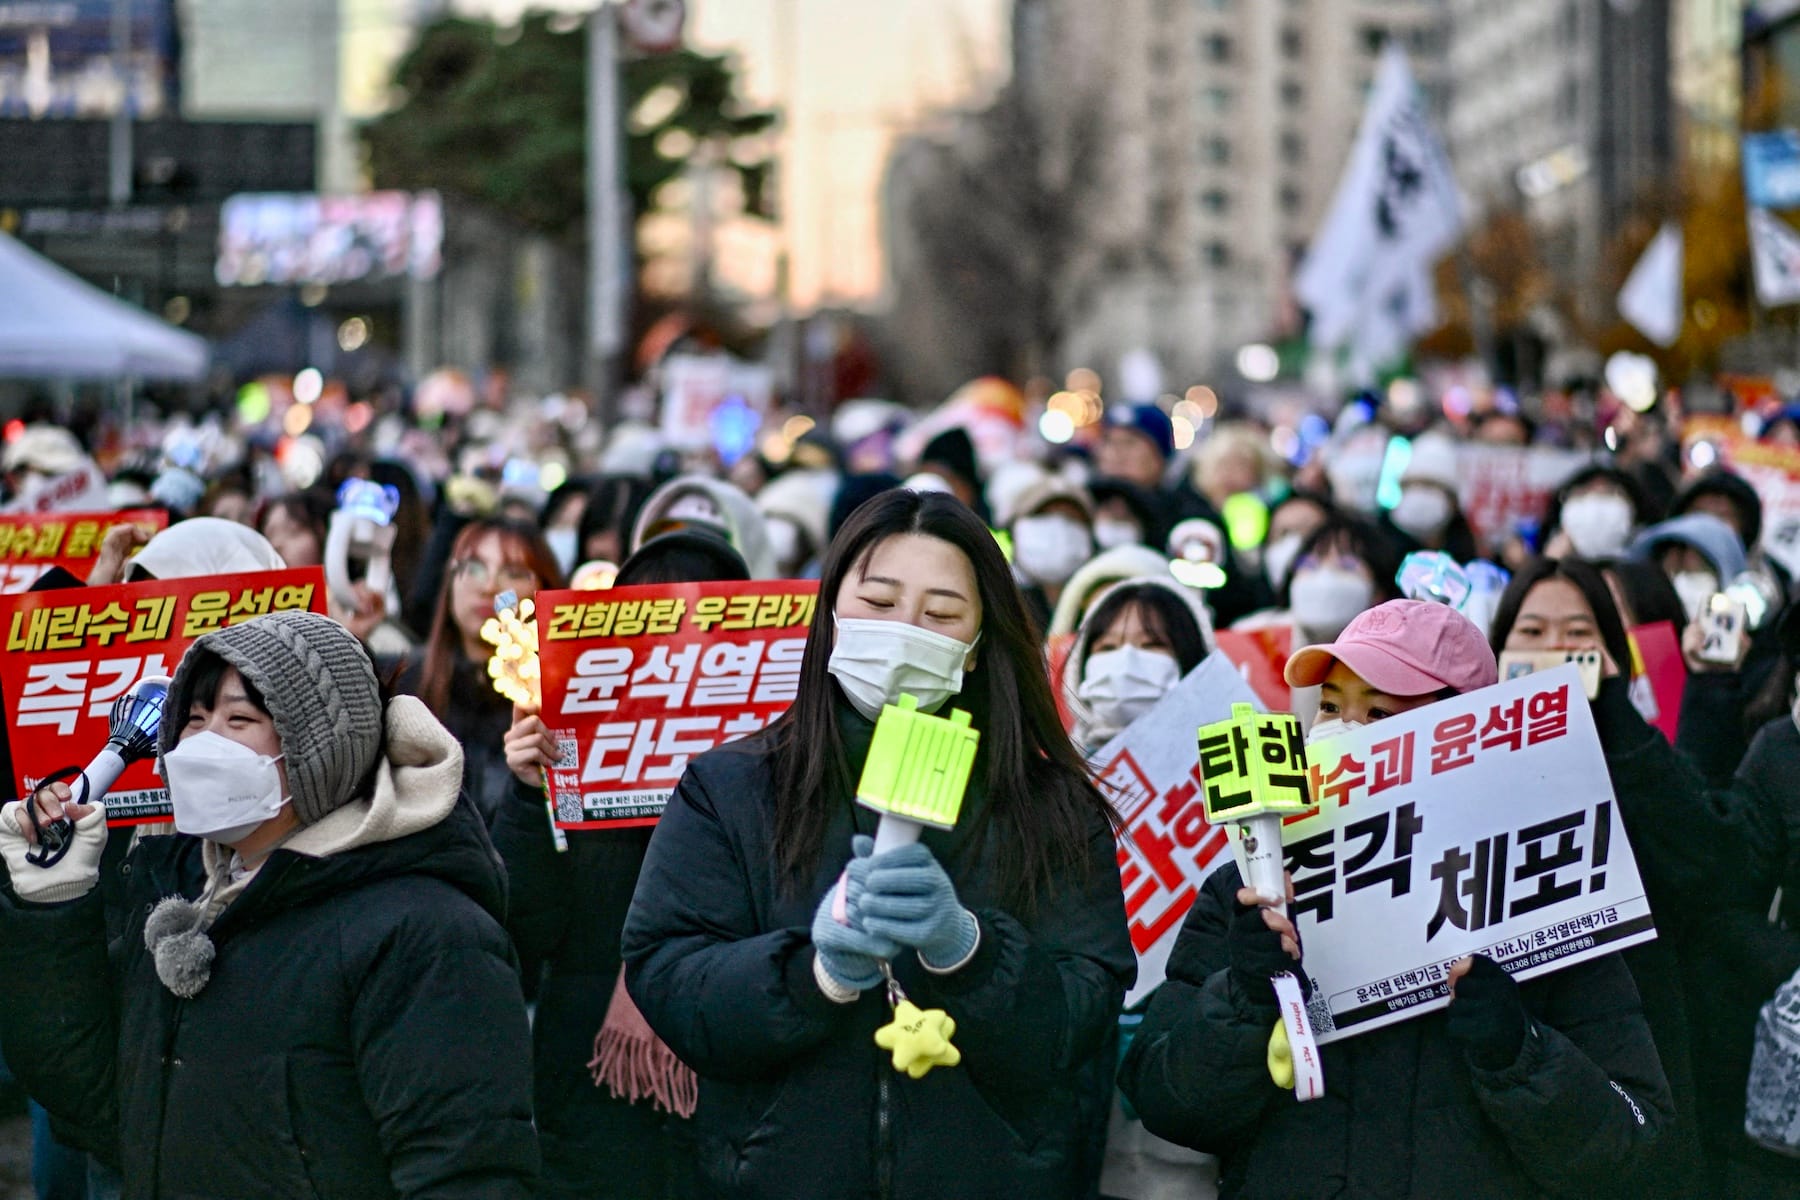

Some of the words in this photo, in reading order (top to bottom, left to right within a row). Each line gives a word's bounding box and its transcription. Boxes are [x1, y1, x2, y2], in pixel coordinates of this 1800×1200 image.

[7, 594, 178, 651] 내란수괴
[547, 597, 686, 640] 건희방탄
[560, 638, 807, 714] 윤석열을
[1198, 720, 1311, 813] 탄핵
[1431, 684, 1569, 776] 윤석열
[1426, 800, 1612, 943] 체포!
[1356, 979, 1393, 1004] 윤석열
[1393, 965, 1442, 992] 탄핵기금
[1496, 907, 1618, 959] bit.ly/윤석열탄핵기금
